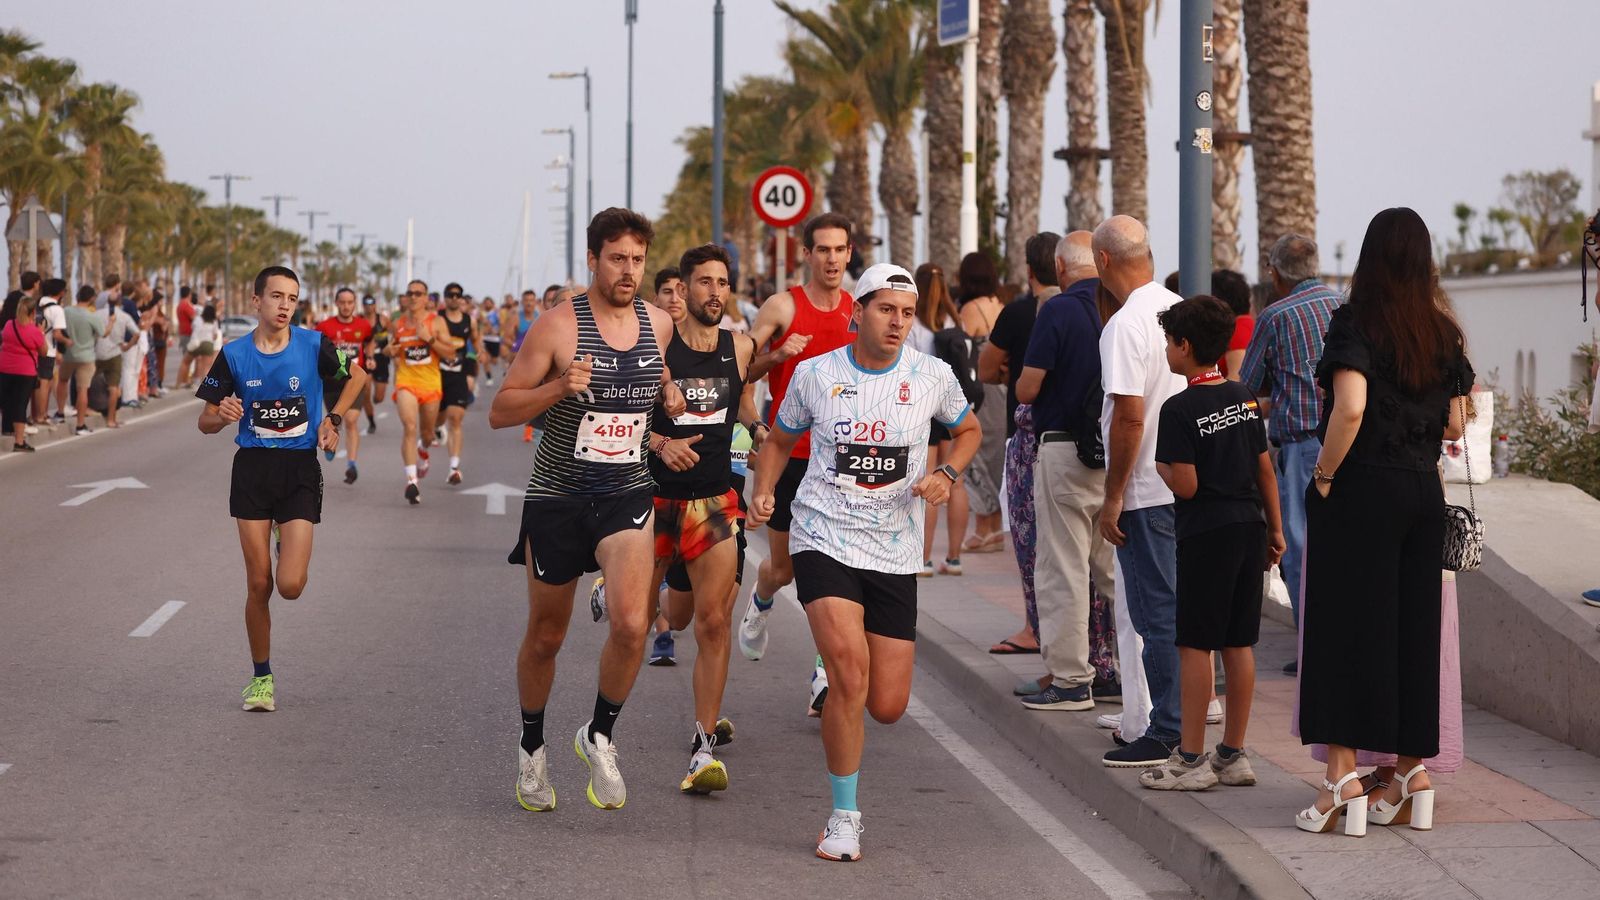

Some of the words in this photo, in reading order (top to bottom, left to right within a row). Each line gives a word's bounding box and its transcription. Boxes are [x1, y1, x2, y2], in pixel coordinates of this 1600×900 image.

[765, 185, 796, 207] 40
[686, 387, 719, 400] 894
[260, 406, 300, 419] 2894
[1196, 402, 1250, 428] POLICIA
[594, 424, 633, 438] 4181
[854, 420, 887, 443] 26
[849, 455, 896, 471] 2818
[844, 501, 872, 511] Marzo
[873, 501, 894, 511] 2025
